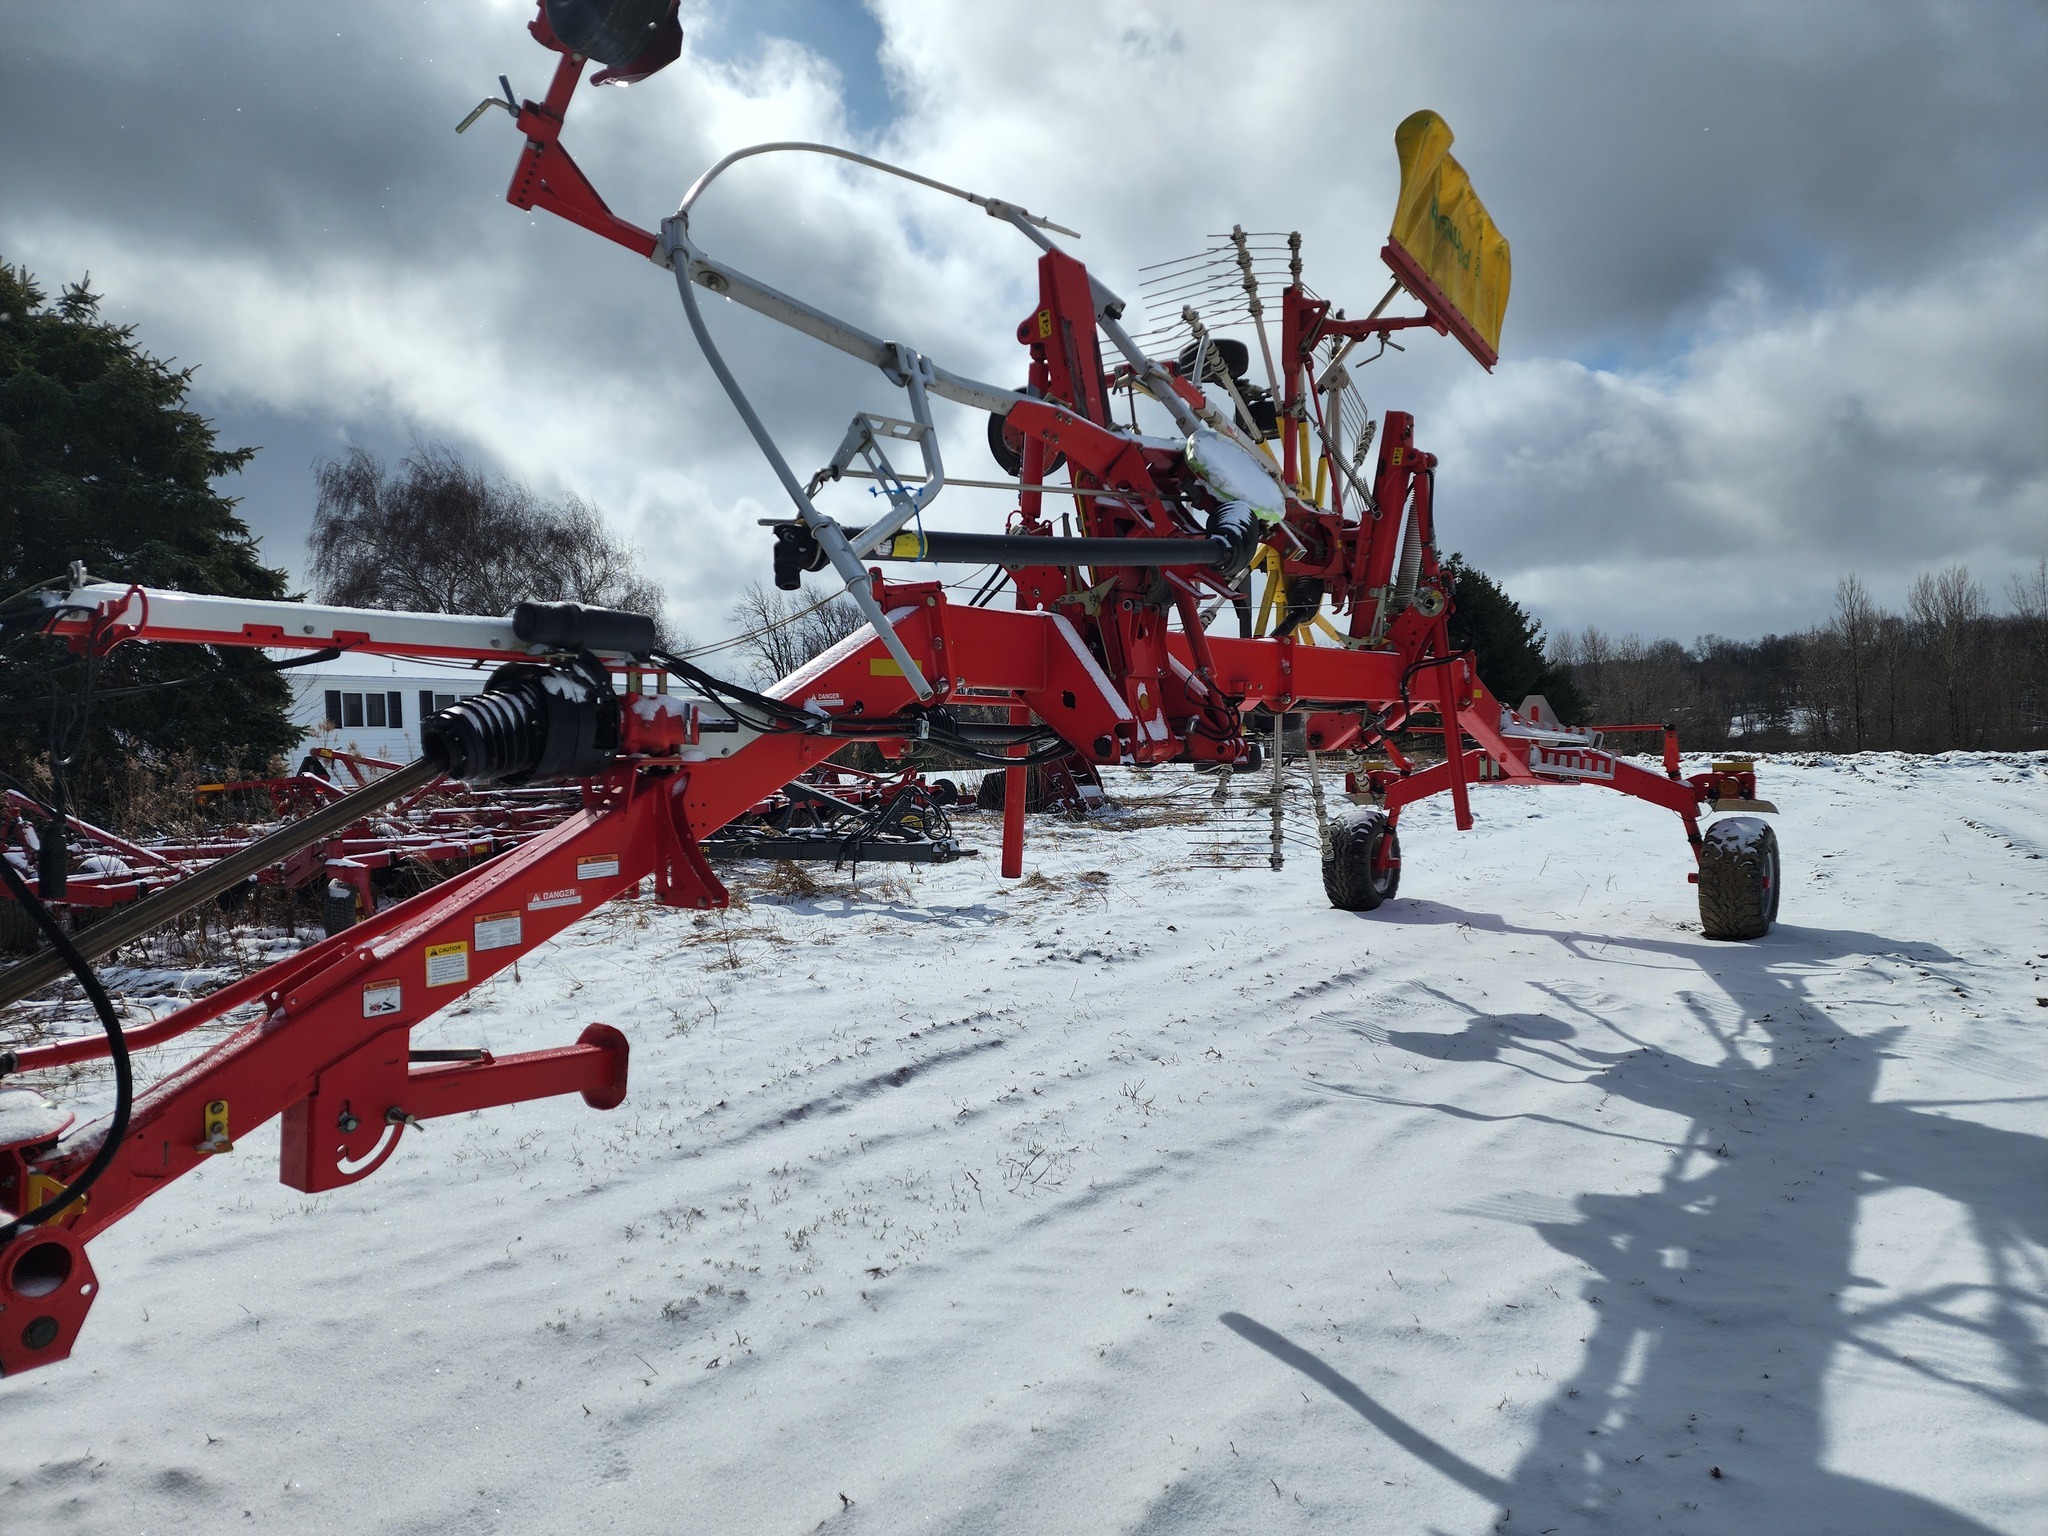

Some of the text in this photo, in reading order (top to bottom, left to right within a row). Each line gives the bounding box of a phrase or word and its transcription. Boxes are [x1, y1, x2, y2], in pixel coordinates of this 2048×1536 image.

[817, 692, 840, 700] DANGER
[542, 888, 576, 900] DANGER
[438, 944, 461, 953] CAUTION
